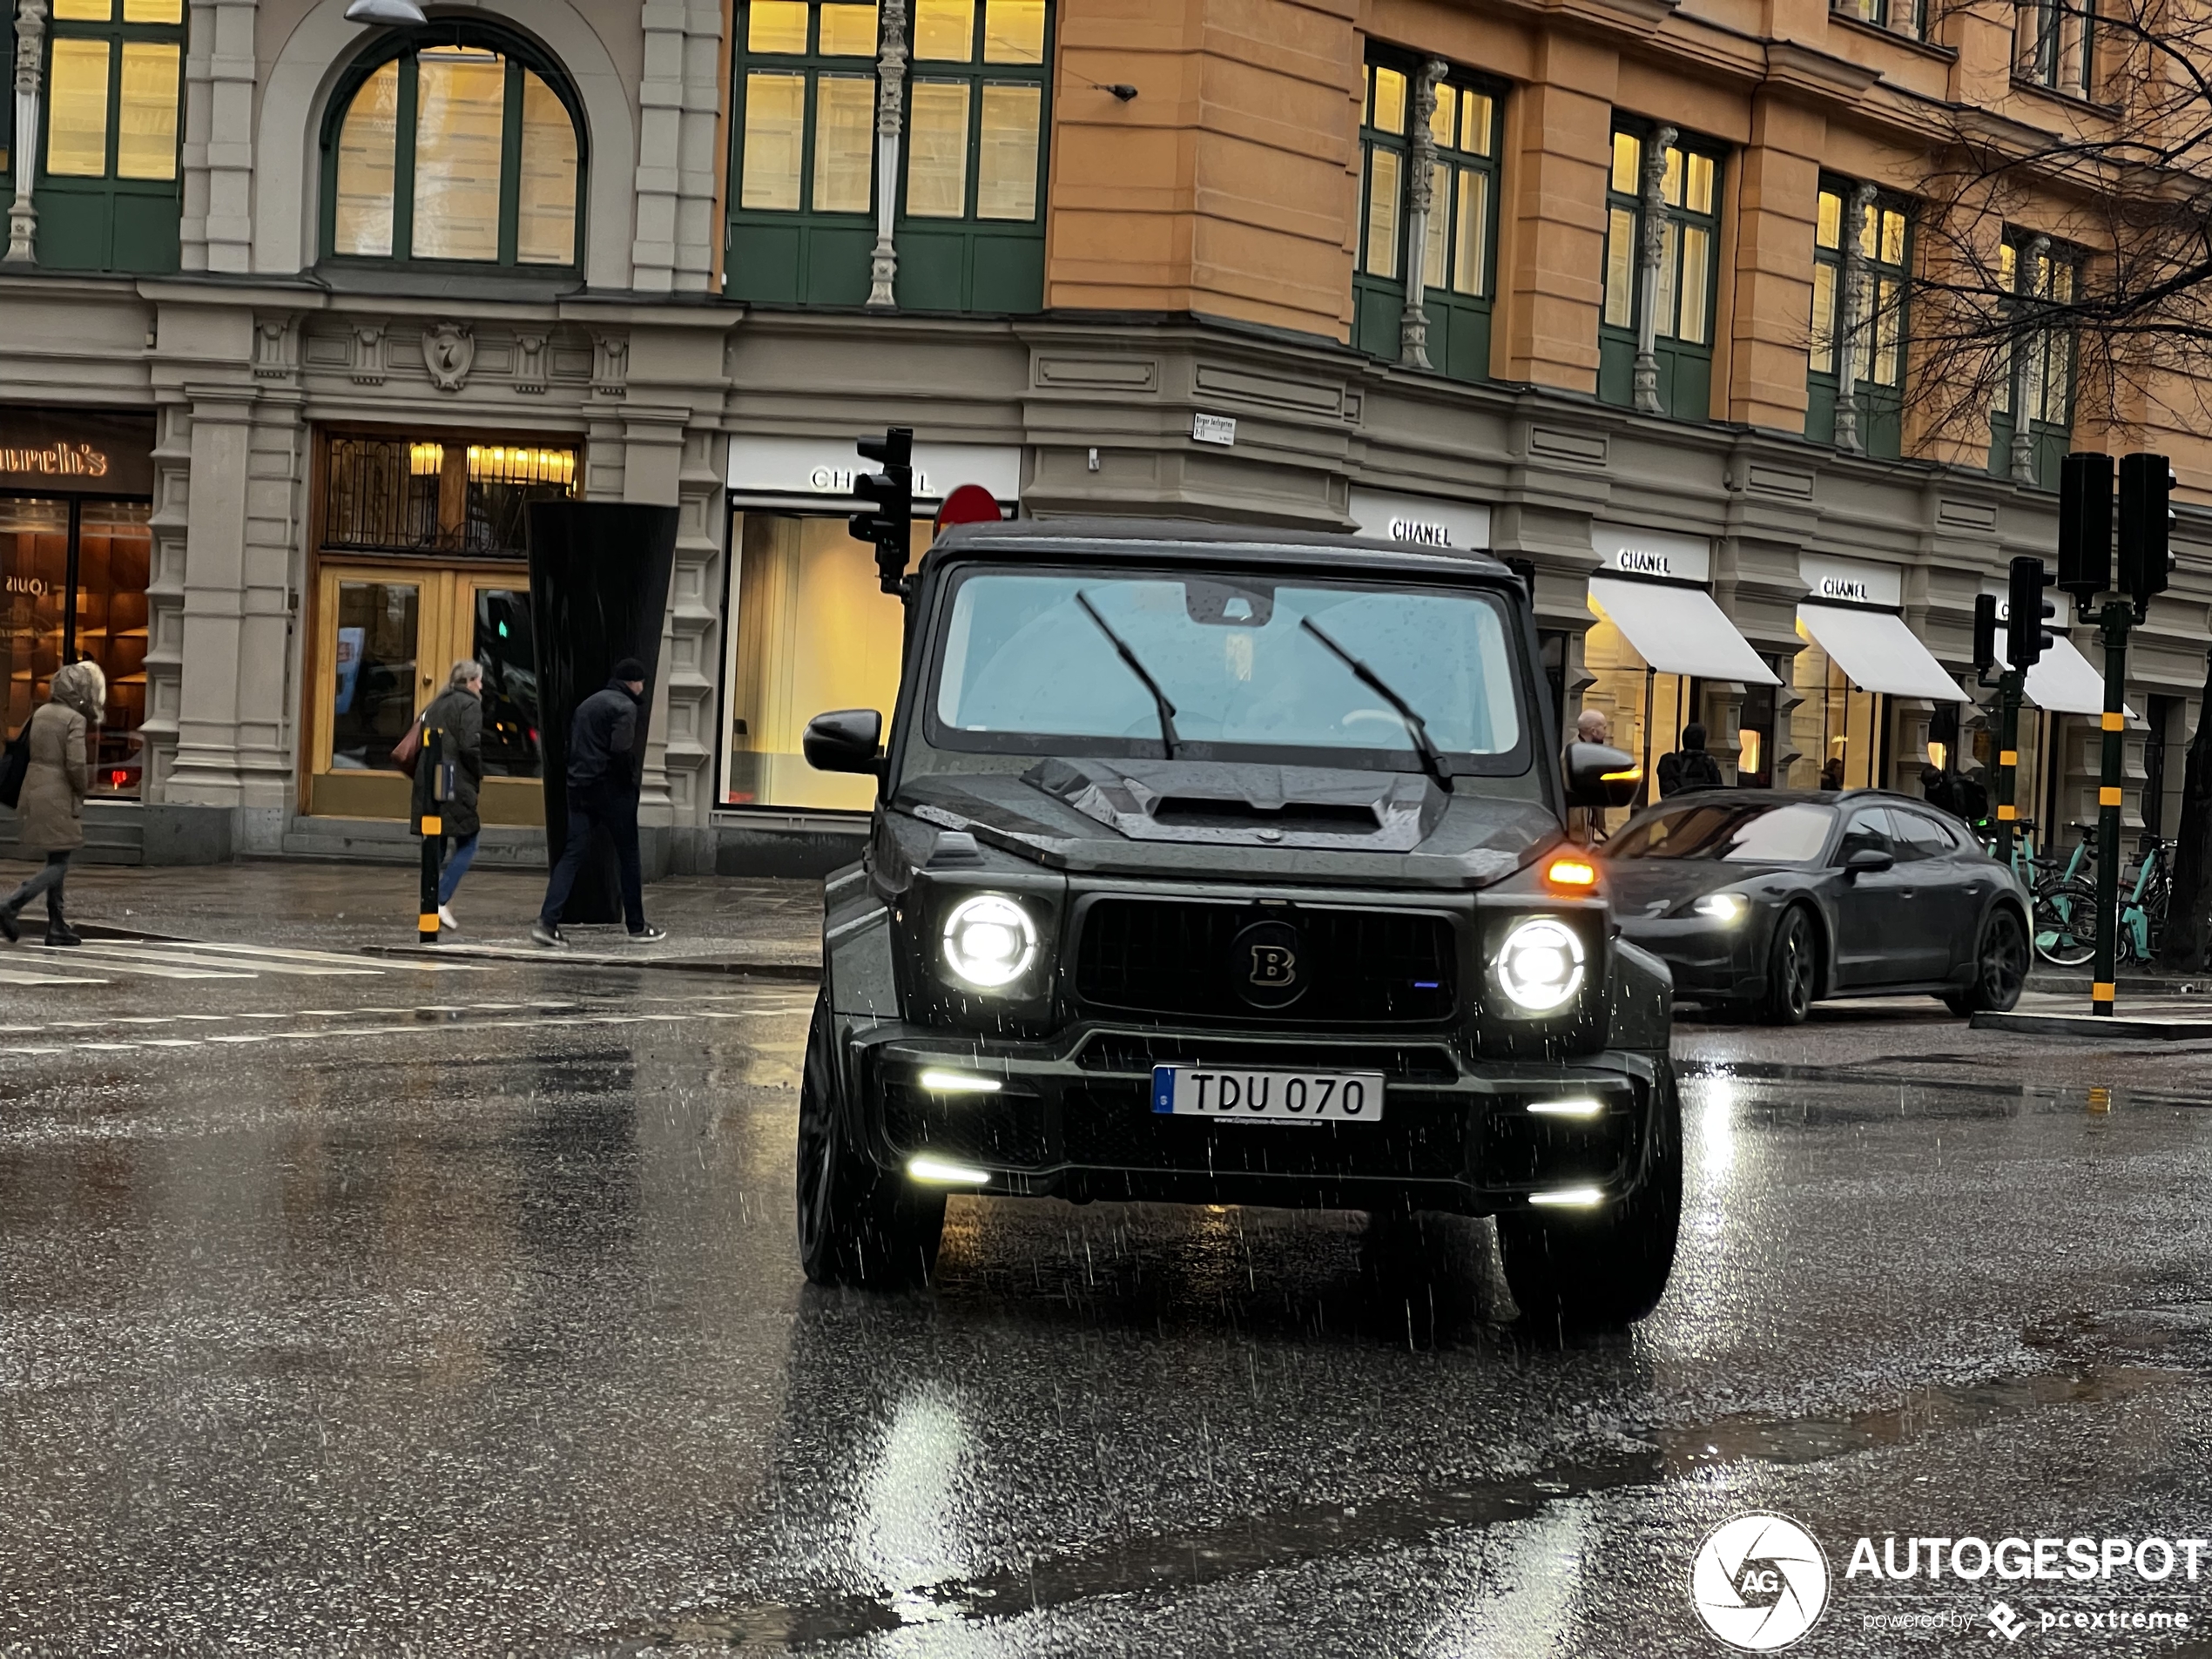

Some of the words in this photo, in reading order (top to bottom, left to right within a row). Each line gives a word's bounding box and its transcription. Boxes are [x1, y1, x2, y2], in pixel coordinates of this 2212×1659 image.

[438, 343, 455, 368] 7
[811, 469, 934, 495] CHL
[1392, 521, 1452, 547] CHANEL
[1620, 551, 1671, 574] CHANEL
[1824, 579, 1867, 599] CHANEL
[1250, 945, 1296, 987] B
[1190, 1074, 1269, 1111] TDU
[1285, 1077, 1365, 1116] 070
